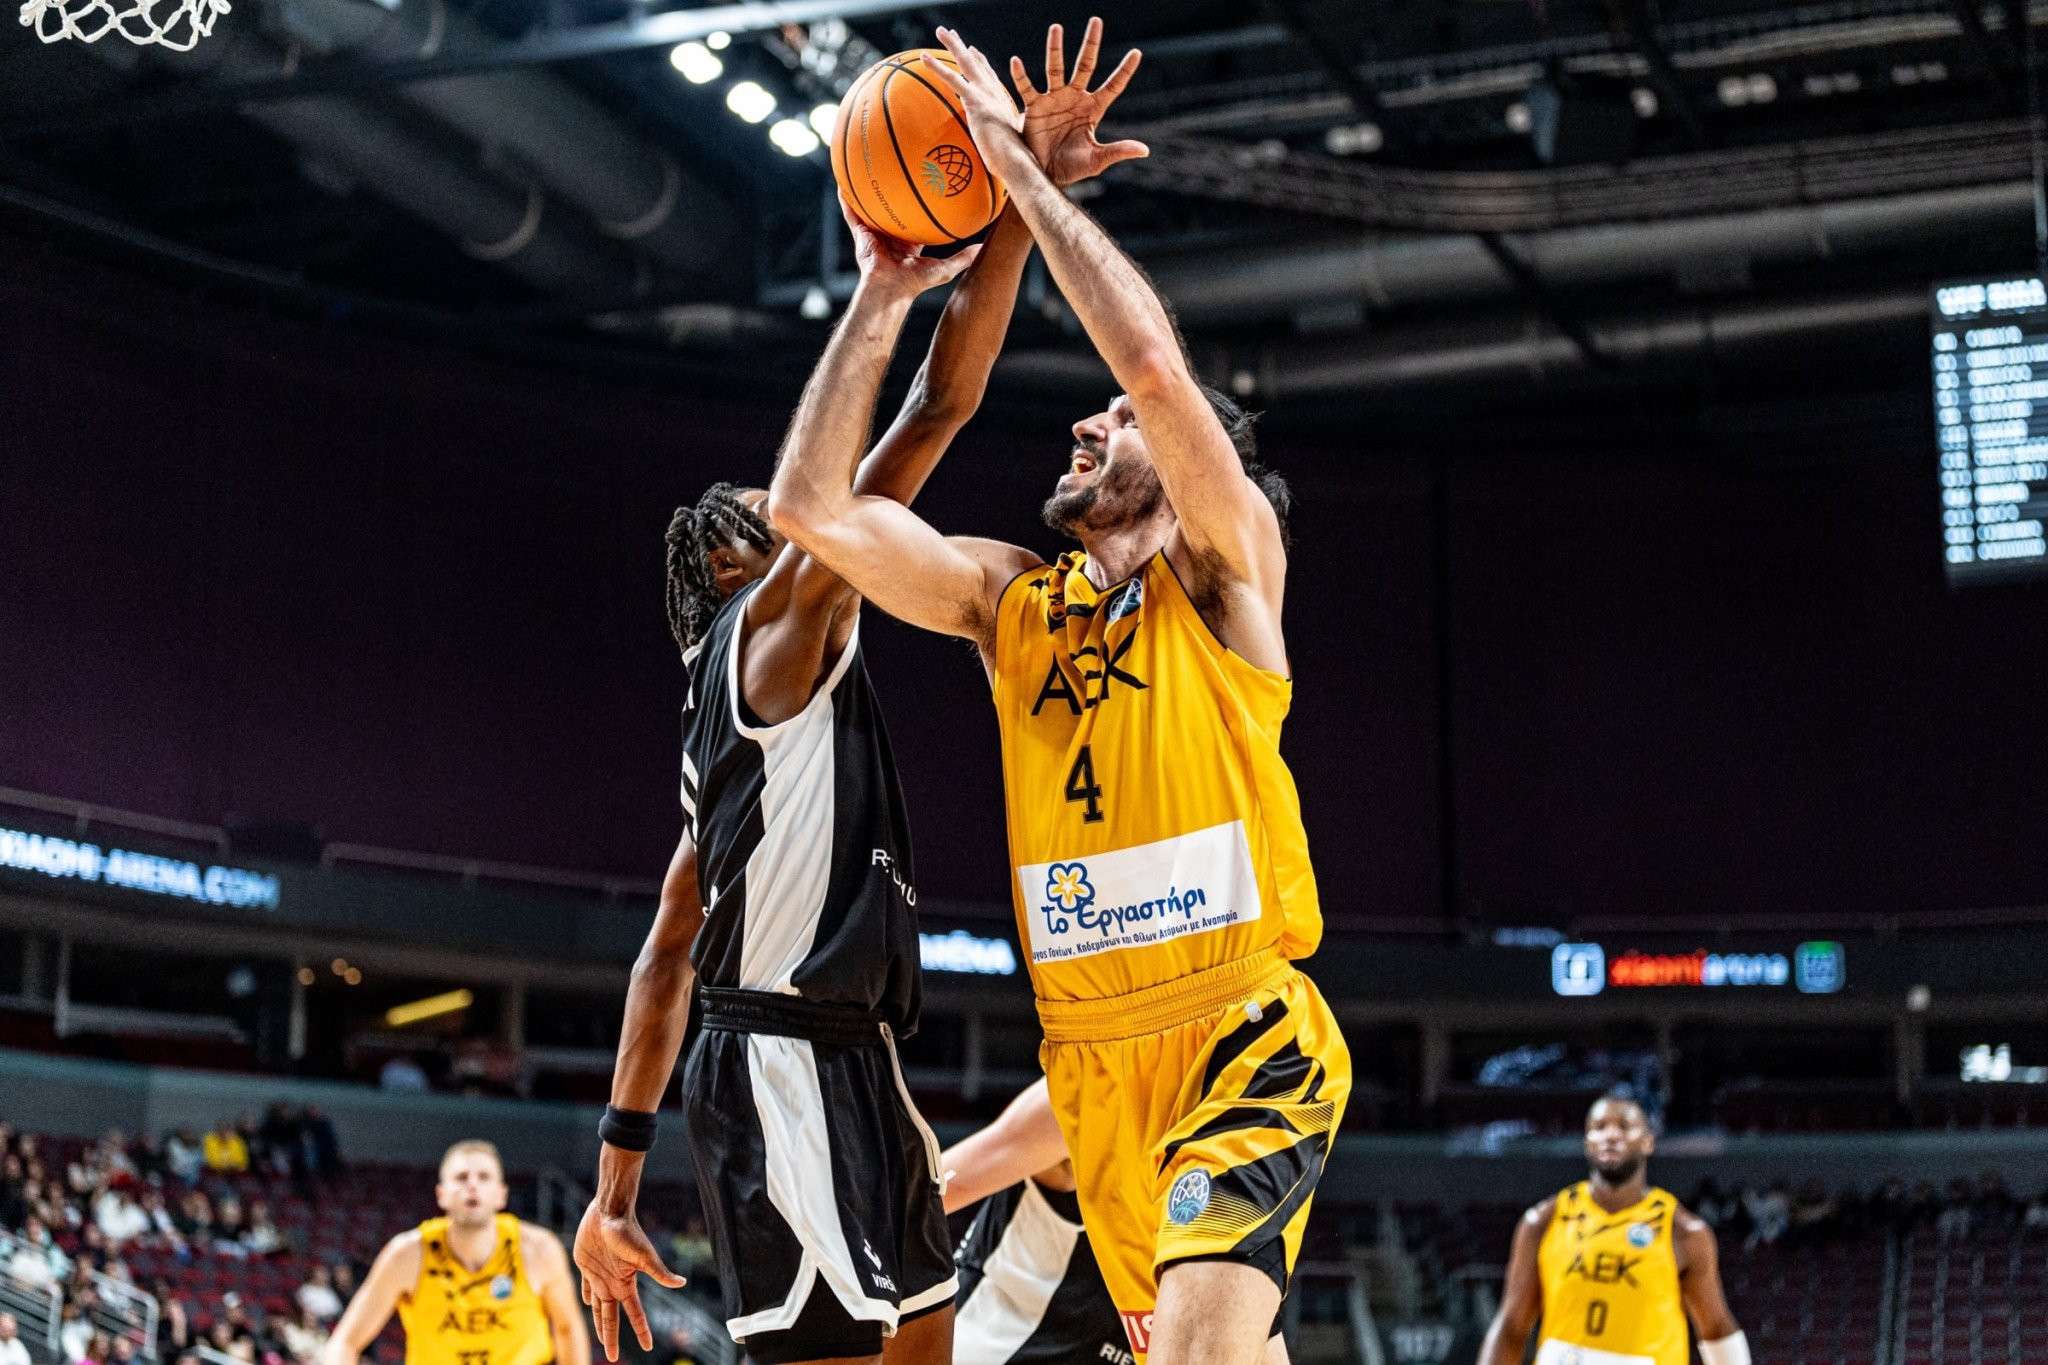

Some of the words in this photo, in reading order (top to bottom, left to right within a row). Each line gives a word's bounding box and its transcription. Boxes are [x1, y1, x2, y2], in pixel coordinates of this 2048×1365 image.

[871, 179, 908, 232] CHAMPIONS
[1031, 622, 1149, 717] AEK
[1064, 744, 1103, 824] 4
[1190, 921, 1200, 932] με
[1565, 1251, 1642, 1289] AEK
[438, 1308, 513, 1334] AEK
[1585, 1299, 1609, 1337] 0
